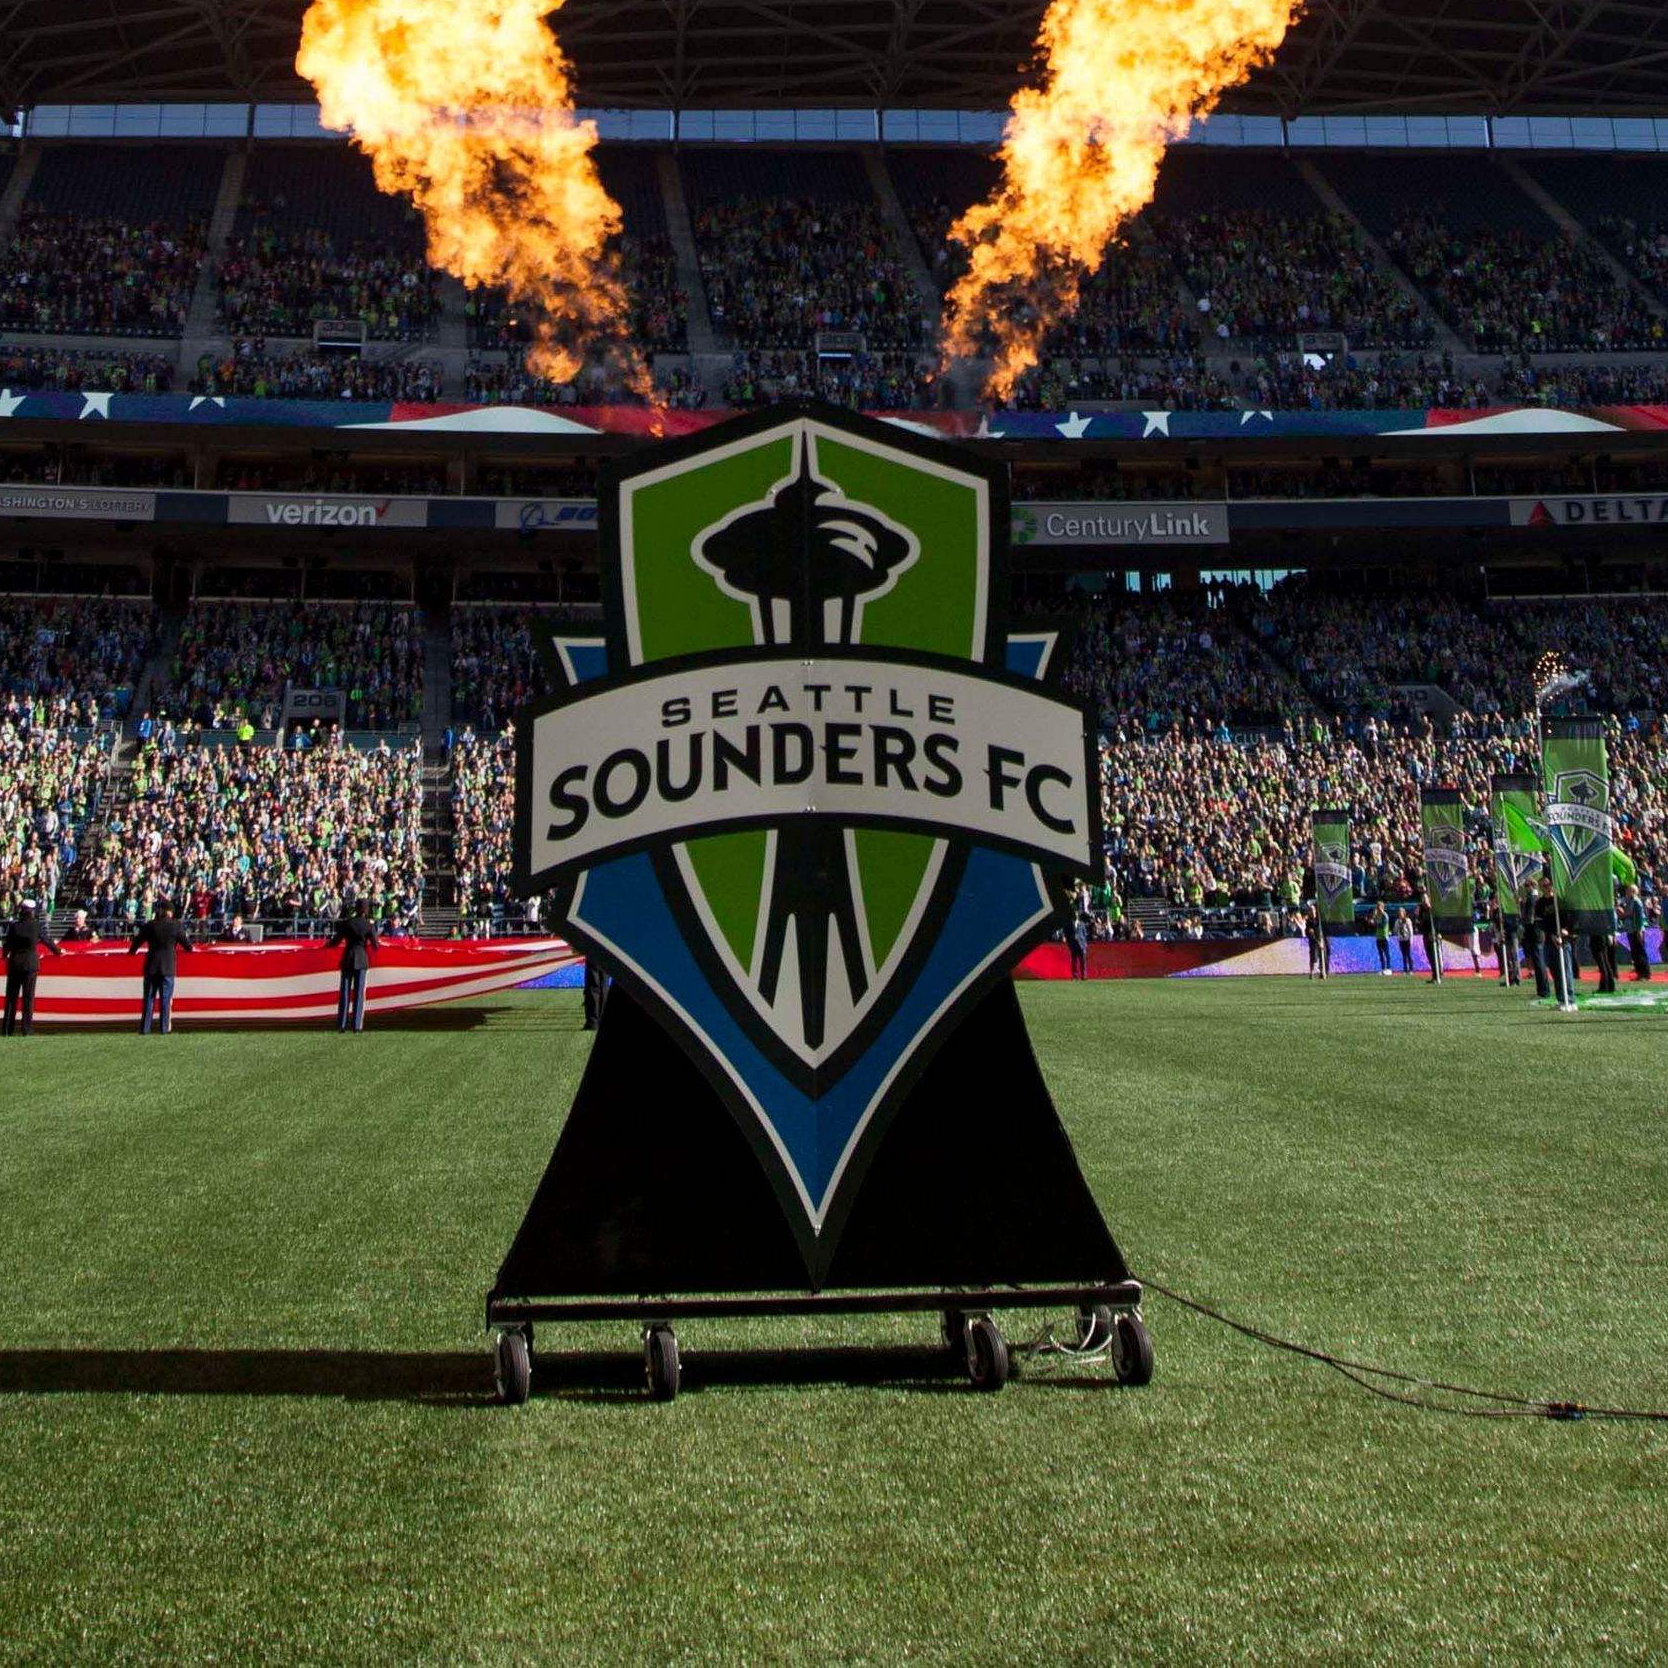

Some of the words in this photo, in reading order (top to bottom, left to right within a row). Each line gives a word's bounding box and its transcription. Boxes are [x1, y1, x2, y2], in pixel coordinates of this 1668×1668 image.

[90, 499, 149, 513] LOTTERY
[266, 499, 378, 526] verizon
[1046, 512, 1210, 541] CenturyLink
[662, 684, 956, 728] SEATTLE
[546, 722, 963, 841] SOUNDERS
[983, 743, 1076, 834] FC
